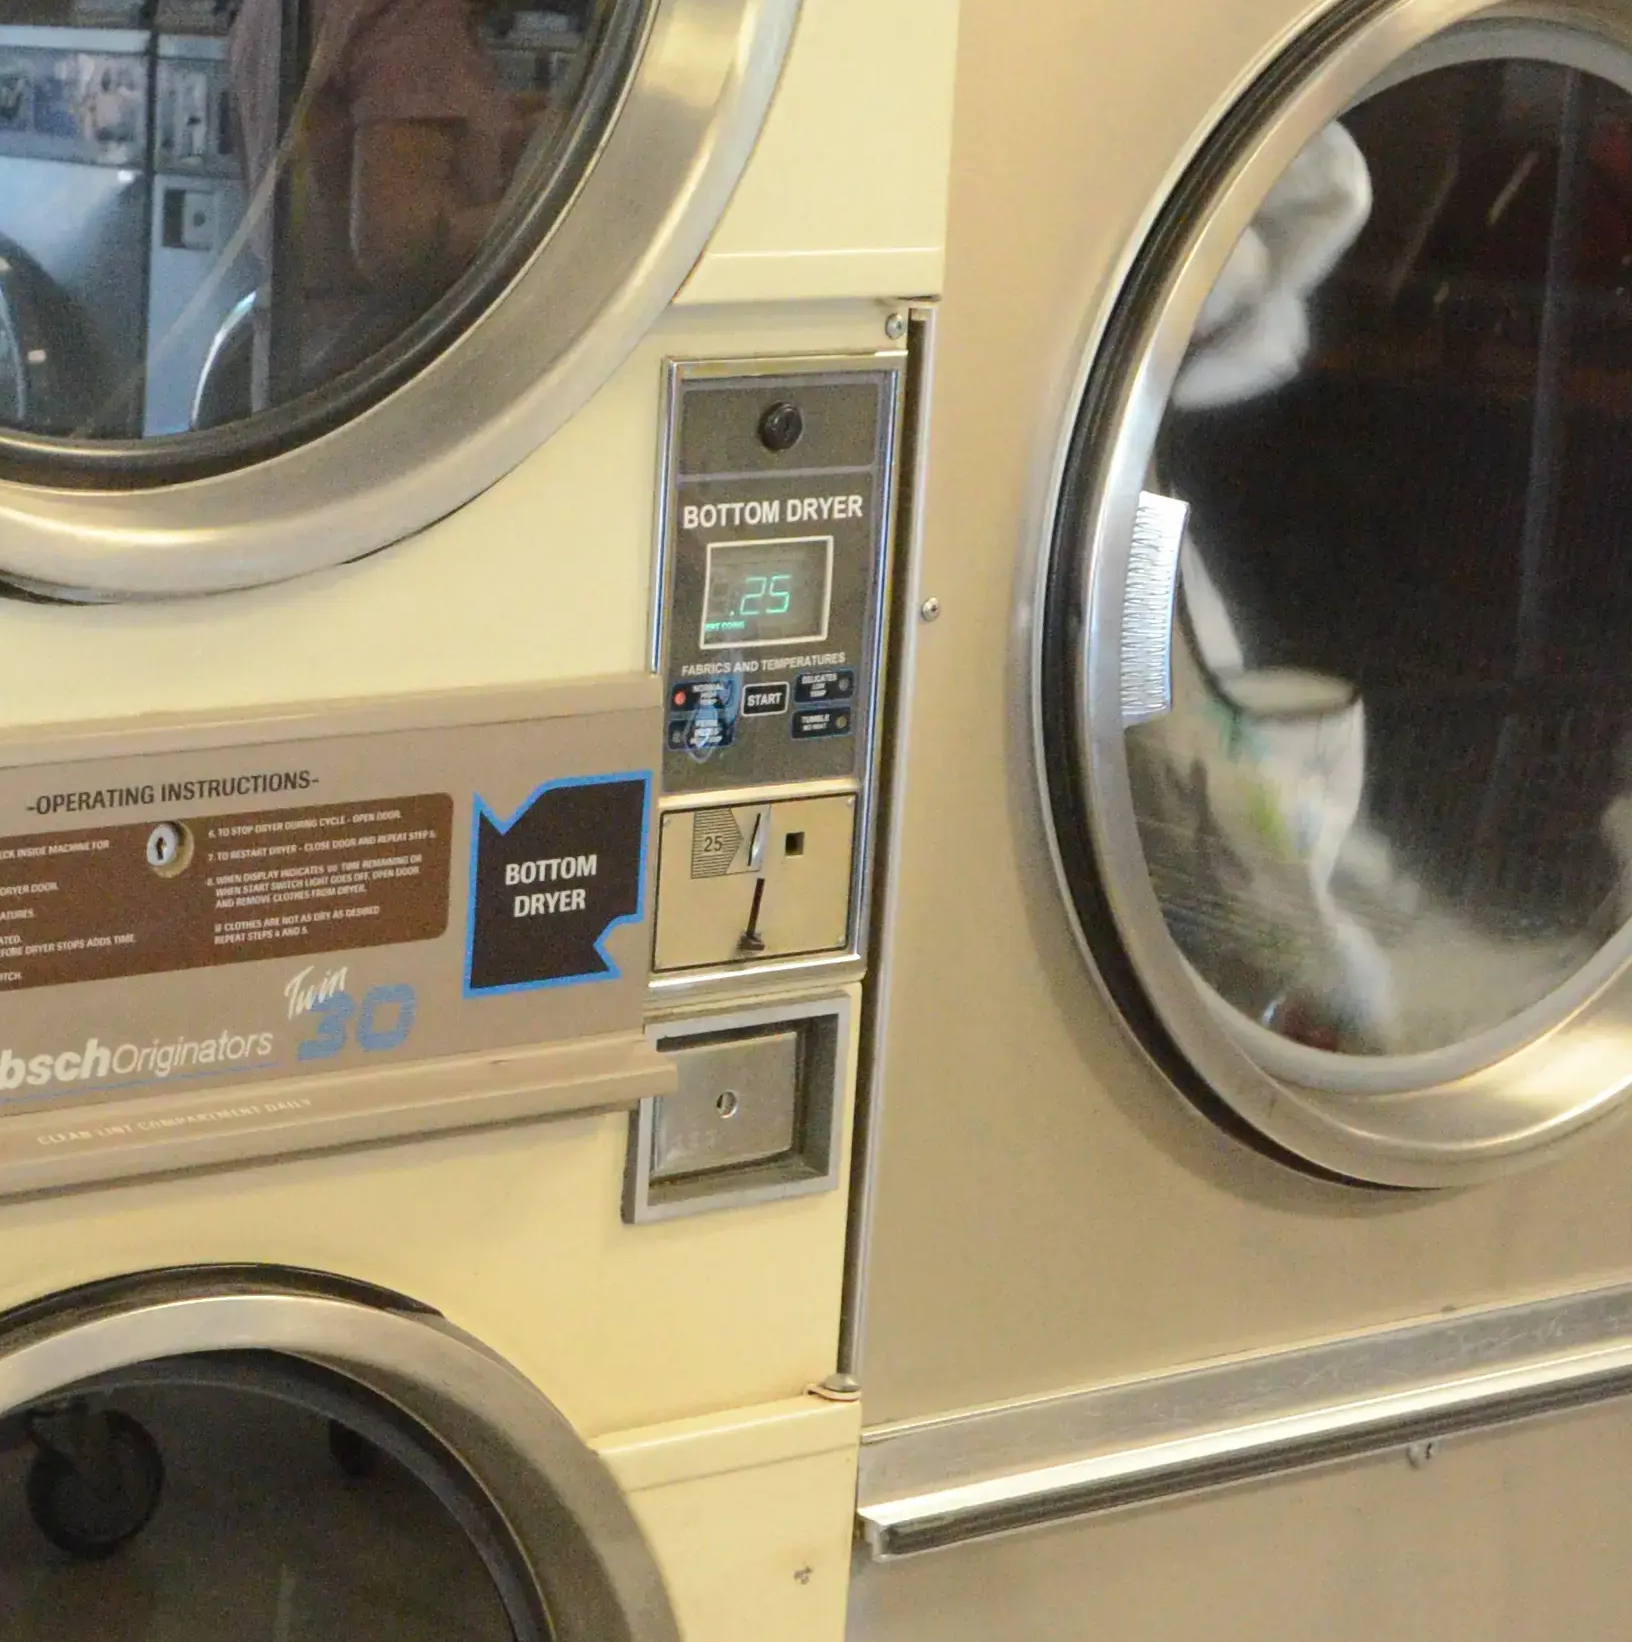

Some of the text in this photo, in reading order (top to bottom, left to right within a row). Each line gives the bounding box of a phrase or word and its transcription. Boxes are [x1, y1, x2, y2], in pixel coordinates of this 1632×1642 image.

[682, 494, 864, 530] BOTTOM DRYER
[681, 651, 846, 677] FABRICS AND TEMPERATURES
[747, 692, 782, 707] START
[218, 827, 230, 837] TO
[231, 825, 254, 836] STOP
[255, 821, 284, 834] DRYER
[285, 818, 317, 830] DURING
[319, 815, 346, 827] CYCLE
[352, 812, 375, 824] OPEN
[17, 846, 46, 858] INSIDE
[48, 842, 90, 855] MACHINE
[92, 840, 110, 850] FOR
[217, 830, 428, 861] TO RESTART DRYER CLOSE DOOR AND REPEAT STEP
[703, 835, 724, 852] 25
[216, 874, 242, 885] WHEN
[243, 870, 279, 882] DISPLAY
[280, 865, 324, 878] INDICATES
[216, 887, 242, 897] WHEN
[243, 883, 269, 895] START
[270, 879, 303, 892] SWITCH
[305, 875, 329, 887] LIGHT
[330, 873, 352, 884] GOES
[372, 868, 394, 880] OPEN
[395, 866, 419, 877] DOOR
[505, 854, 598, 885] BOTTOM
[0, 884, 29, 896] DRYER
[216, 899, 235, 909] AND
[236, 894, 270, 907] REMOVE
[272, 890, 310, 903] CLOTHES
[311, 887, 336, 898] FROM
[513, 888, 586, 918] DRYER
[224, 919, 262, 932] CLOTHES
[263, 916, 280, 926] ARE
[281, 915, 299, 925] NOT
[300, 912, 312, 922] AS
[313, 911, 331, 921] DRY
[332, 908, 344, 919] AS
[345, 905, 380, 917] DESIRED
[24, 943, 55, 955] DRYER
[56, 939, 85, 951] STOPS
[86, 936, 112, 948] ADDS
[214, 927, 300, 945] REPEAT STEPS AND
[284, 964, 417, 1061] Twin 30
[37, 1098, 313, 1146] CLEAN LINT COMPARTMENT DAILY
